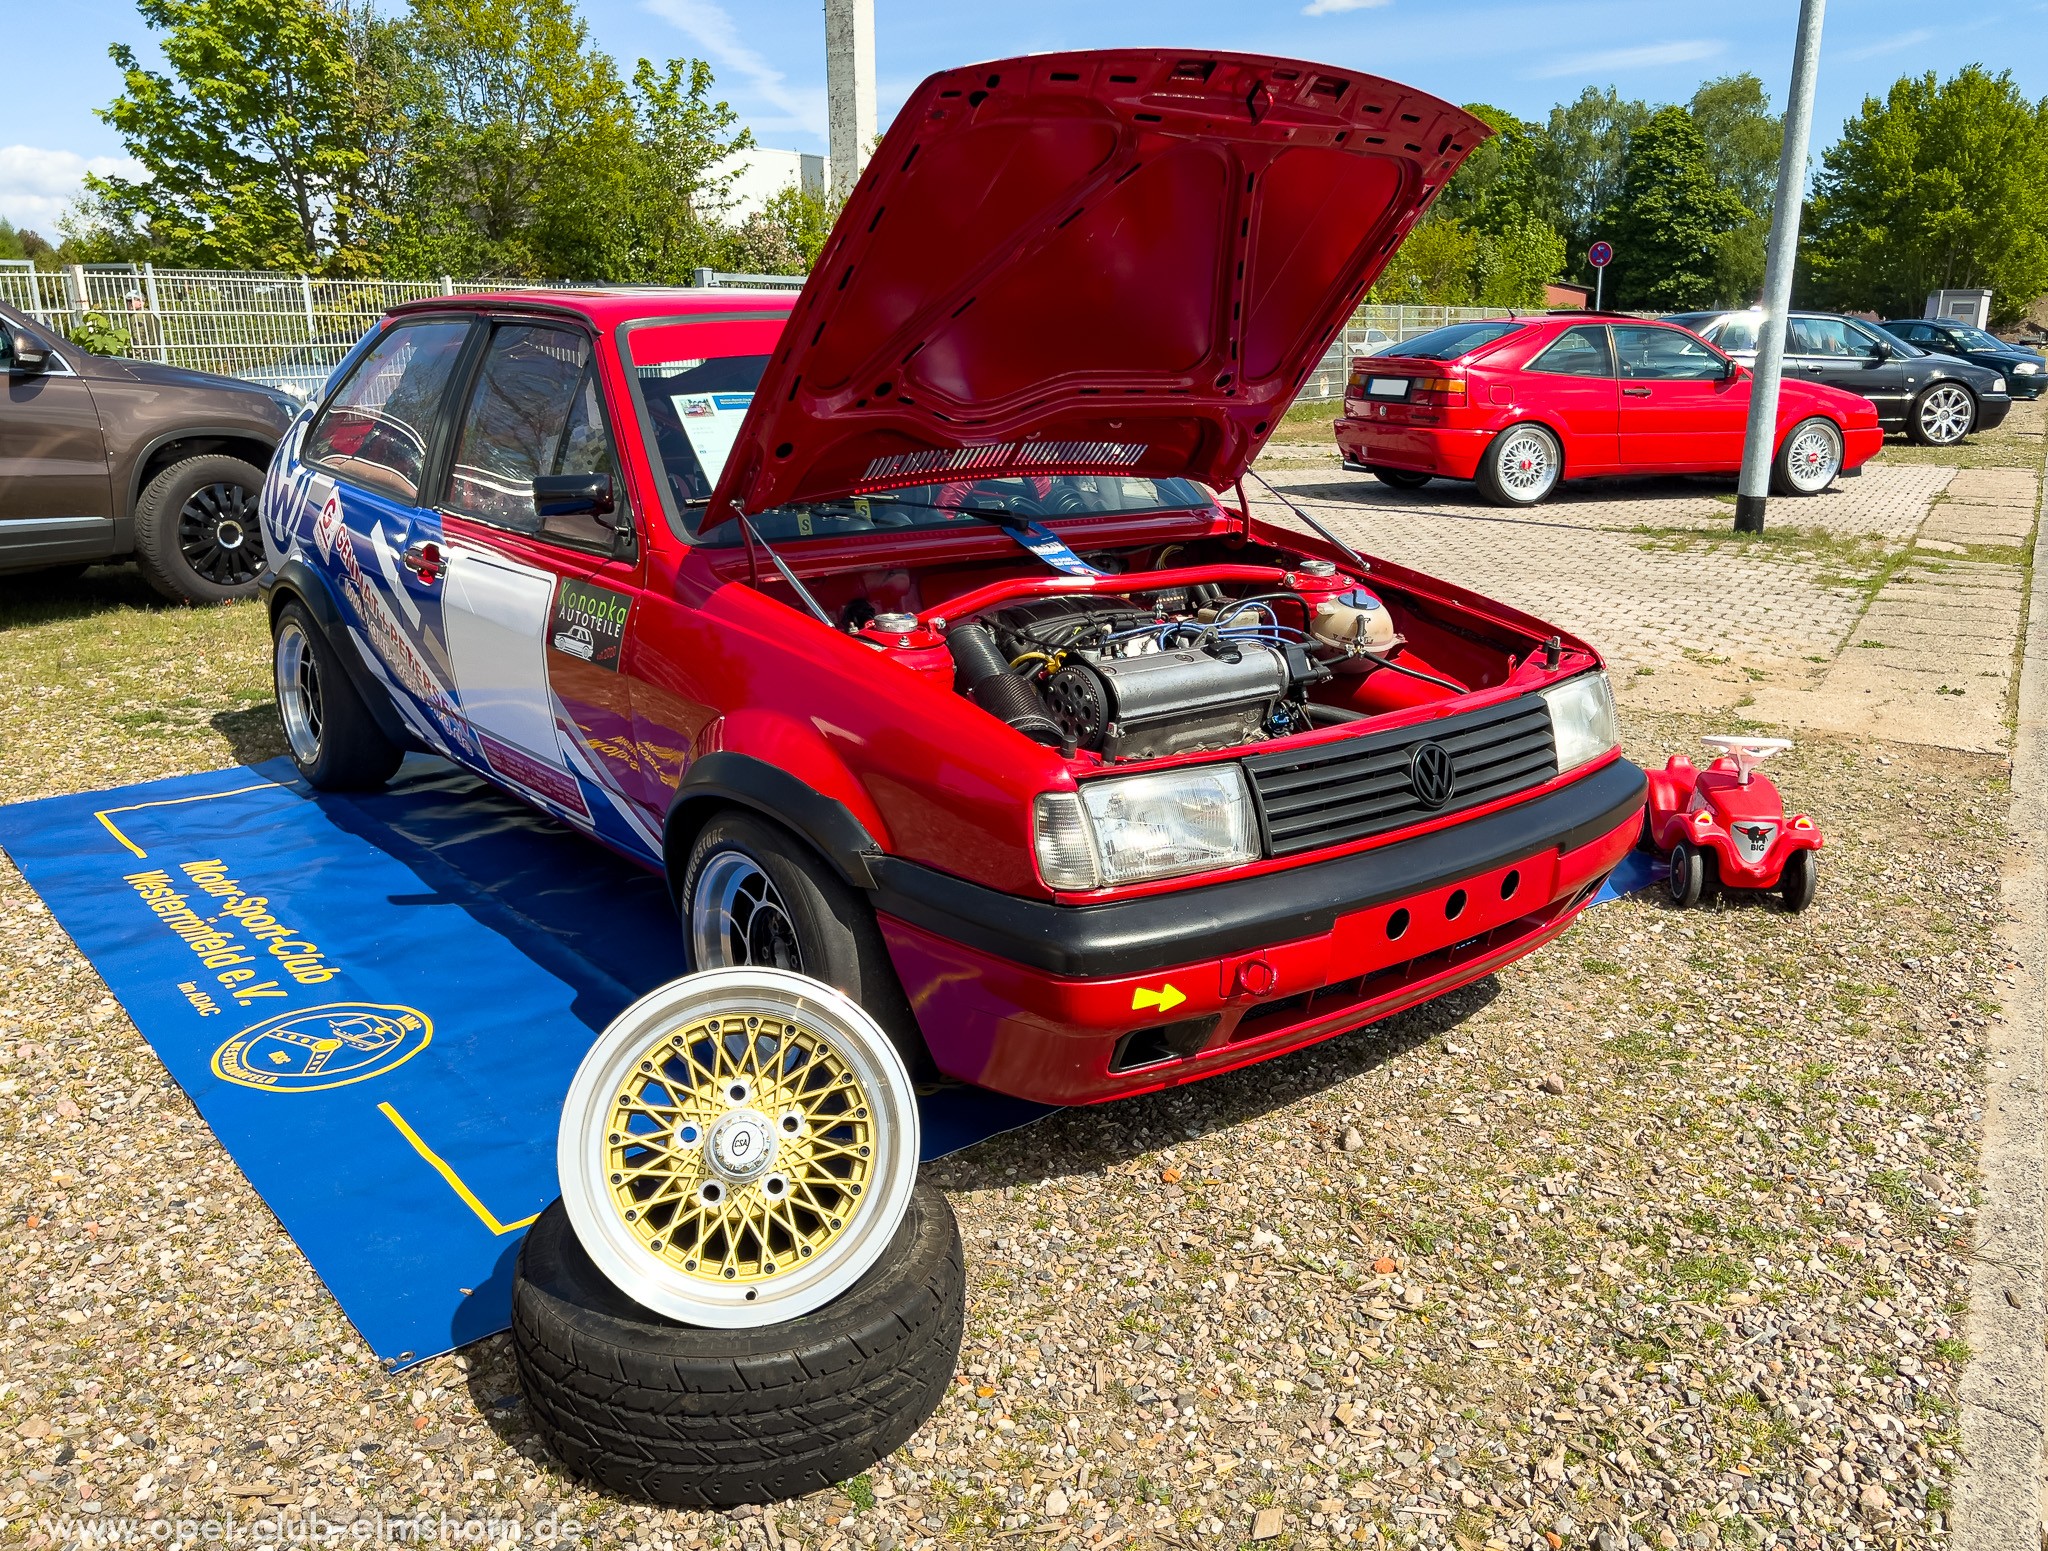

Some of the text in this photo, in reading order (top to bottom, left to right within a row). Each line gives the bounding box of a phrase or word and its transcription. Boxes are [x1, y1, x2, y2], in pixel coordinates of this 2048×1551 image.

[558, 606, 621, 638] AUTOTEILE
[560, 582, 627, 625] Konopka
[179, 858, 342, 985] Motor-Sport-Club
[184, 991, 222, 1017] ADAC
